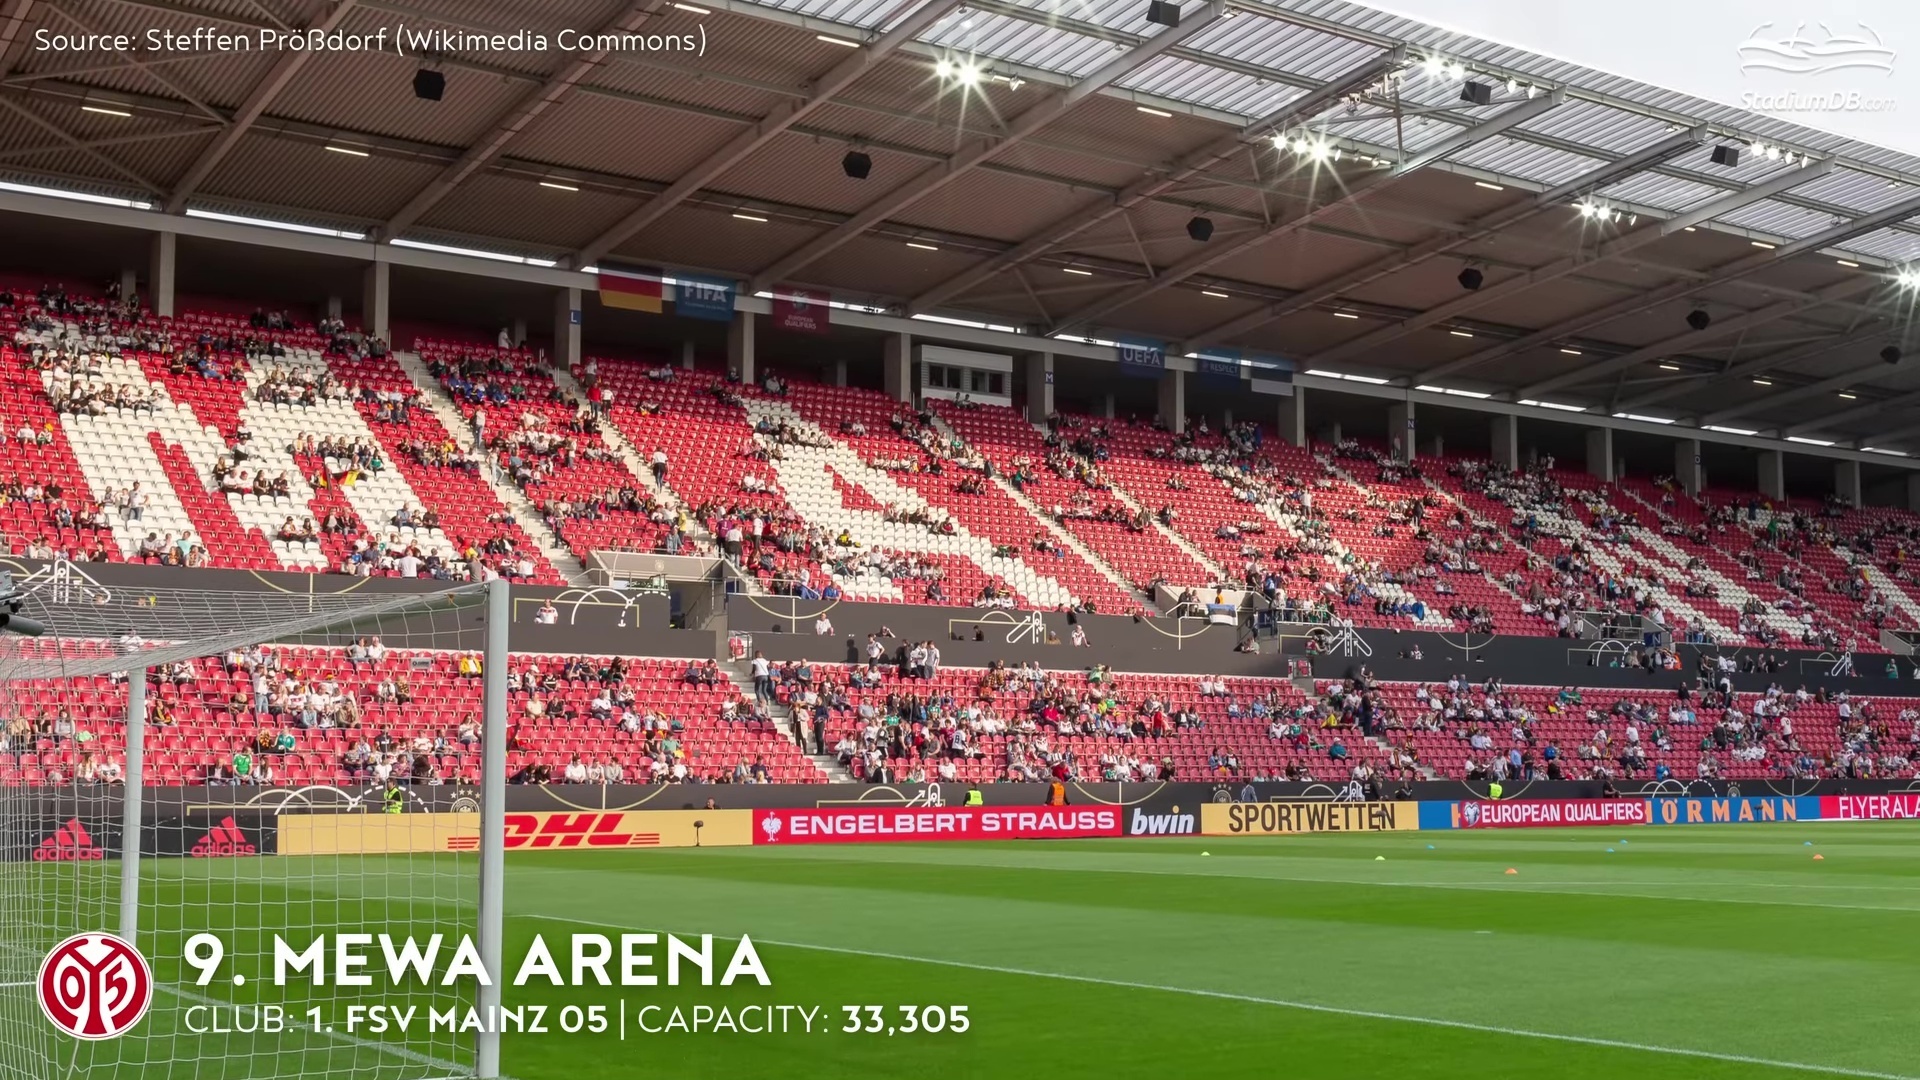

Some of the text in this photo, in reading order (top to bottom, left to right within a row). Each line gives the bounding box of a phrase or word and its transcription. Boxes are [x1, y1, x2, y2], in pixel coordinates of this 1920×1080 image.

[685, 284, 727, 303] FIFA
[570, 311, 577, 322] L
[784, 320, 817, 330] QUALIFIERS
[1123, 348, 1161, 366] UEFA
[1209, 363, 1239, 375] RESPECT
[1045, 373, 1054, 383] M
[1407, 420, 1415, 429] N
[1652, 633, 1661, 645] N
[1131, 805, 1195, 835] bwin
[1228, 803, 1396, 832] SPORTWETTEN
[1481, 803, 1560, 823] EUROPEAN
[1565, 802, 1644, 822] QUALIFIERS
[504, 813, 633, 848] DHL
[790, 811, 1115, 835] ENGELBERT STRAUSS
[33, 846, 103, 861] adidas
[191, 842, 256, 858] adidas
